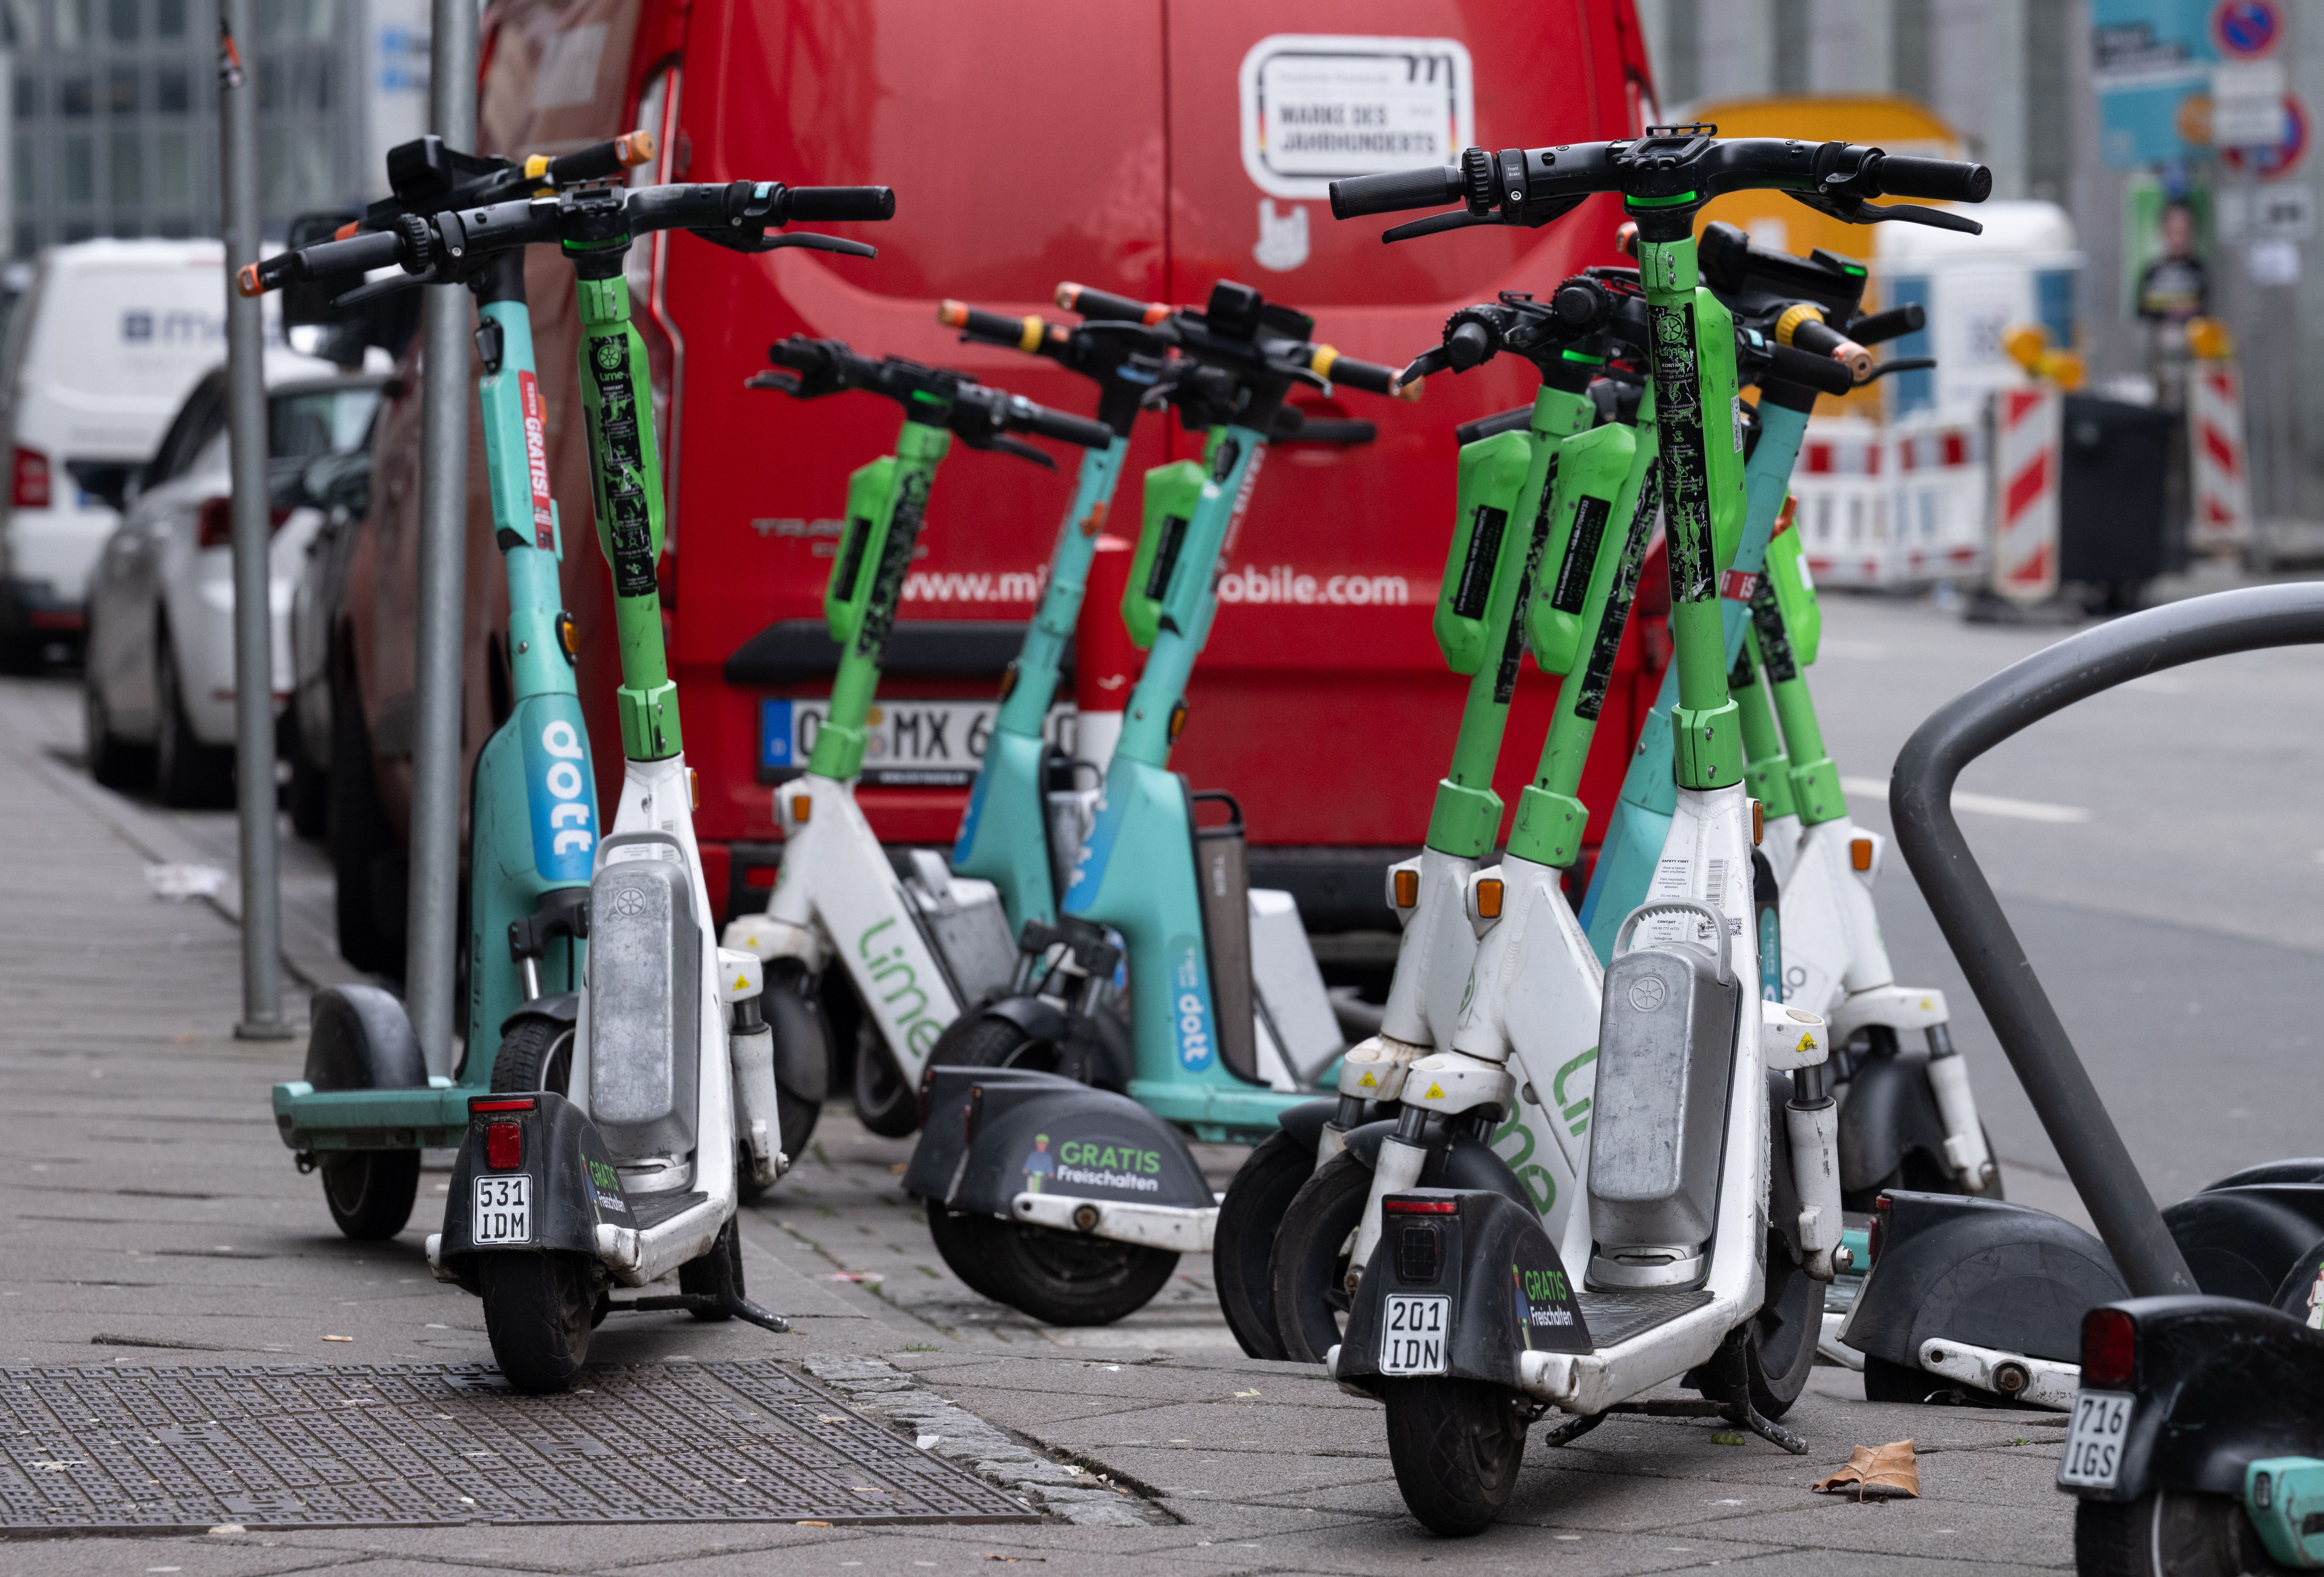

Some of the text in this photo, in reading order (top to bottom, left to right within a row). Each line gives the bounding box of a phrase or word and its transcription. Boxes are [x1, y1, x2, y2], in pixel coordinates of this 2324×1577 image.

[893, 711, 949, 757] MX
[542, 720, 593, 855] dott
[859, 916, 945, 1058] Lime
[1178, 993, 1209, 1062] dott
[1060, 1141, 1160, 1174] GRATIS
[590, 1160, 619, 1192] GRATIS
[1057, 1165, 1159, 1192] Freischalten
[480, 1180, 525, 1207] 531
[597, 1190, 626, 1213] Freischalten
[481, 1212, 524, 1240] IDM
[1525, 1270, 1567, 1301] GRATIS
[1391, 1302, 1441, 1331] 201
[1529, 1305, 1573, 1326] Freischalten
[1389, 1339, 1438, 1369] IDN
[2079, 1400, 2123, 1434] 716
